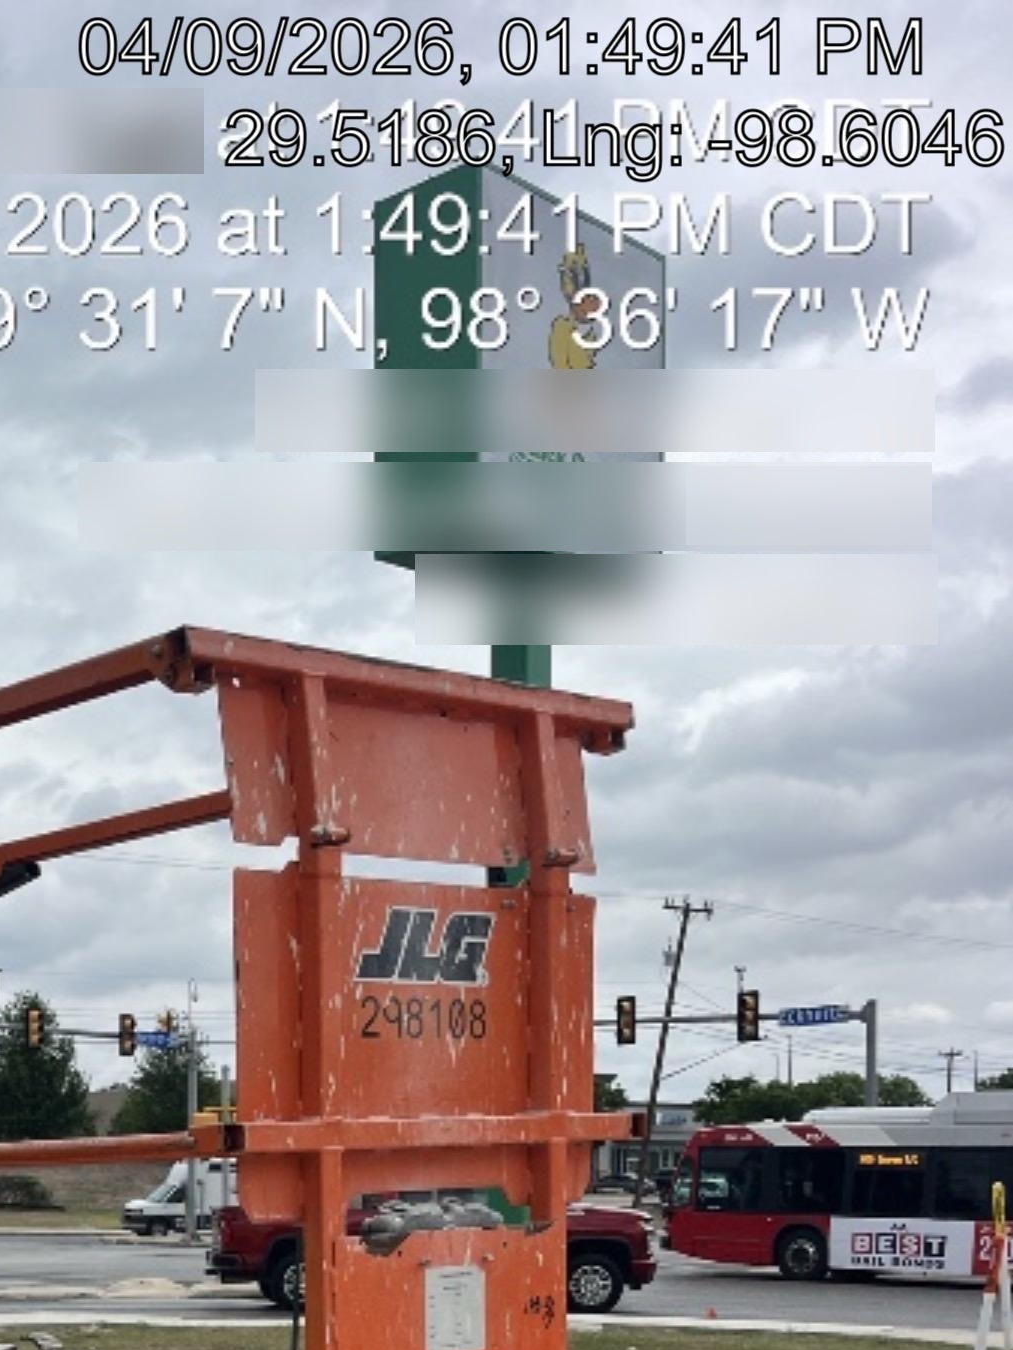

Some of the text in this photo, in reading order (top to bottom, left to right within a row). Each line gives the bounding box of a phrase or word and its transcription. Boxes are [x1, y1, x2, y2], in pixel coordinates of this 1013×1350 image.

[355, 906, 496, 987] JLG
[361, 996, 487, 1040] 298108
[852, 1233, 947, 1257] BEST
